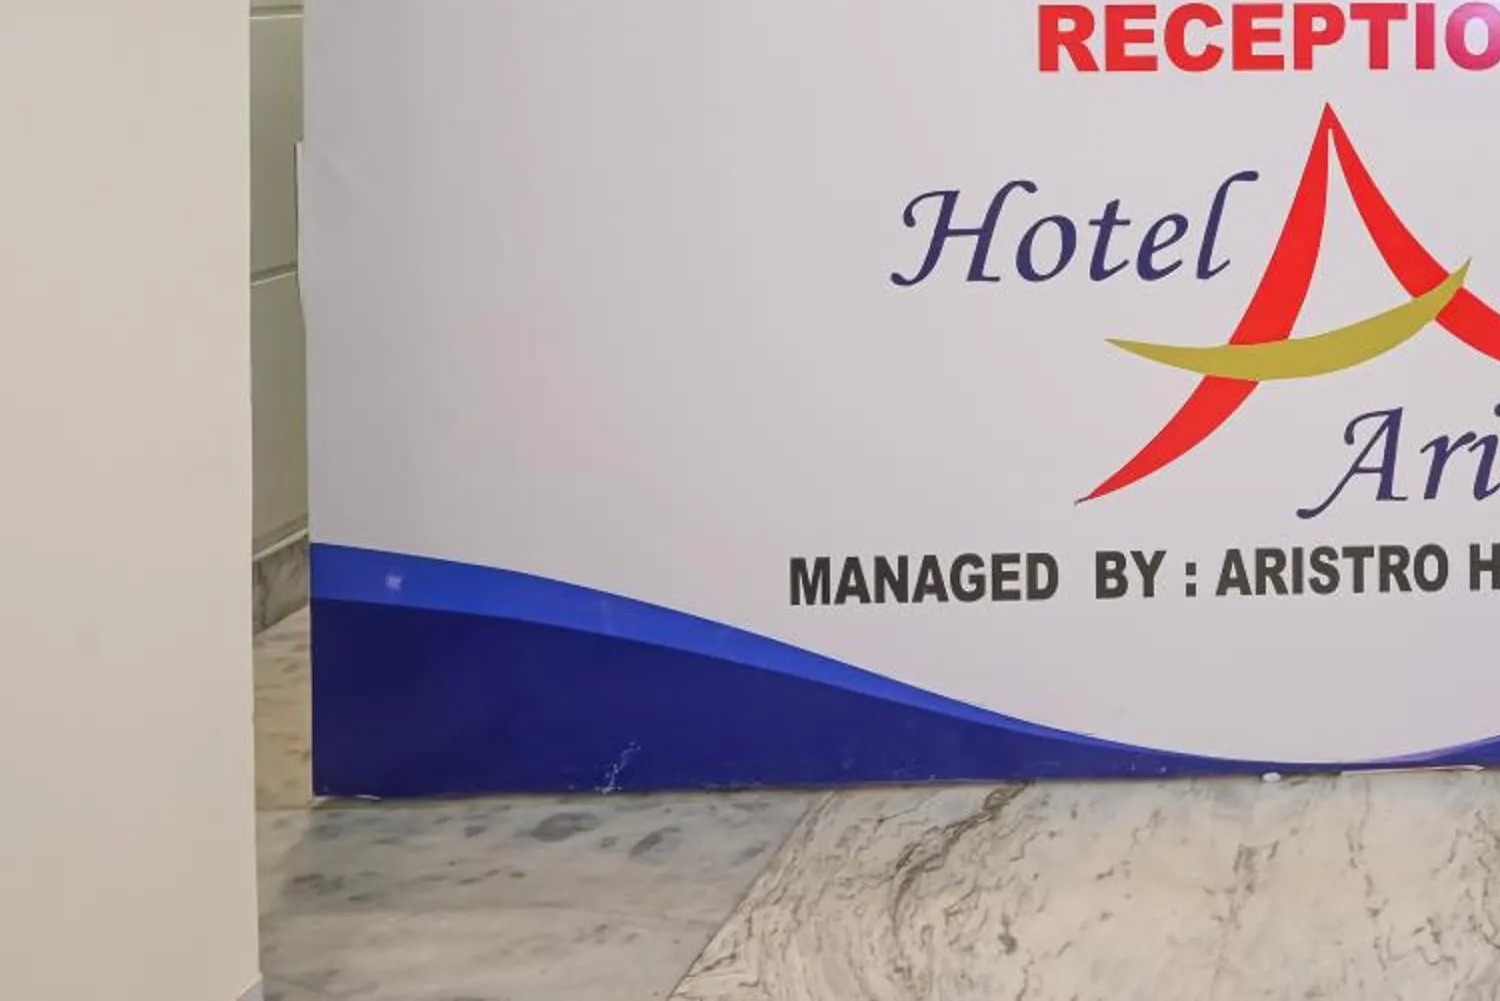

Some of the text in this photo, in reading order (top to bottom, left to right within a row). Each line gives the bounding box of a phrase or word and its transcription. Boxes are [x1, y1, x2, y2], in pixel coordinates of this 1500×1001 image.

[890, 170, 1260, 287] Hotel
[789, 552, 1060, 607] MANAGED
[1095, 550, 1167, 600] BY
[1215, 543, 1450, 597] ARISTRO
